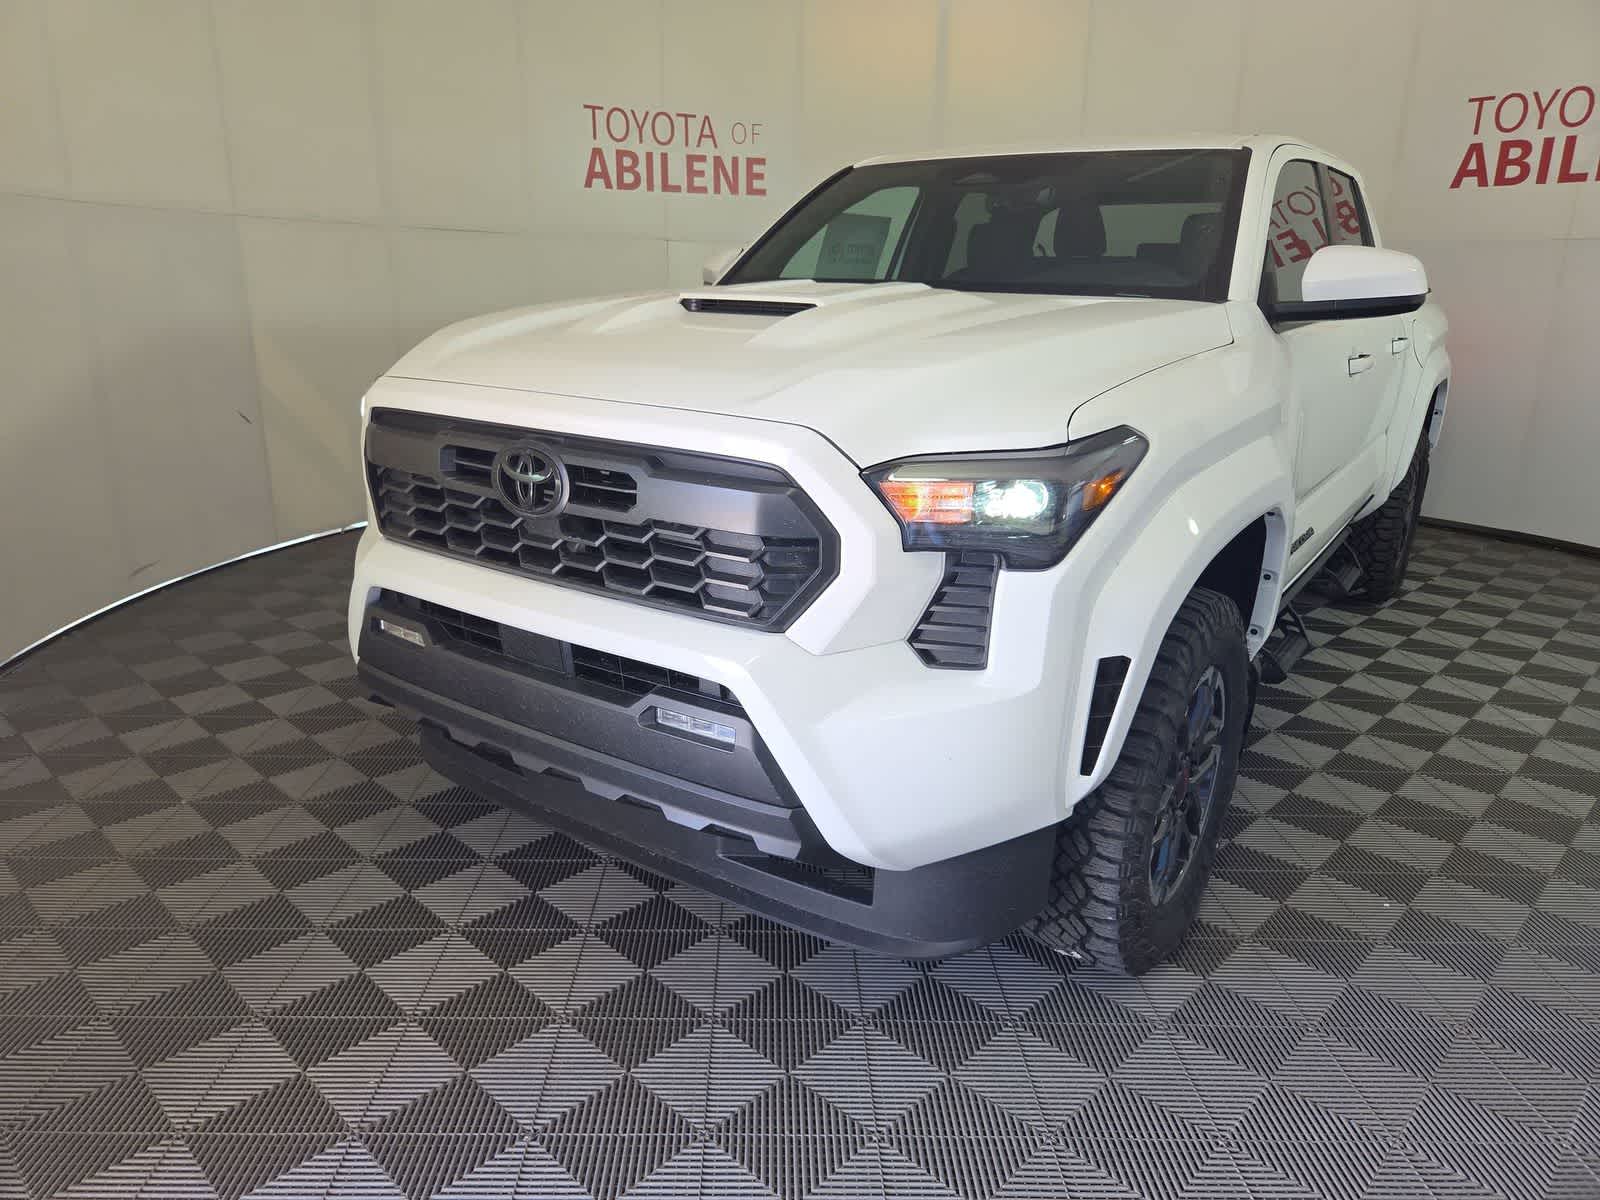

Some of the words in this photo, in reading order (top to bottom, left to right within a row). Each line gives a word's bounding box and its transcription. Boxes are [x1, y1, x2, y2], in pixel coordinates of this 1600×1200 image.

[583, 104, 717, 148] TOYOTA
[731, 121, 763, 144] OF
[584, 147, 767, 196] ABILENE
[1449, 135, 1600, 189] ABIL
